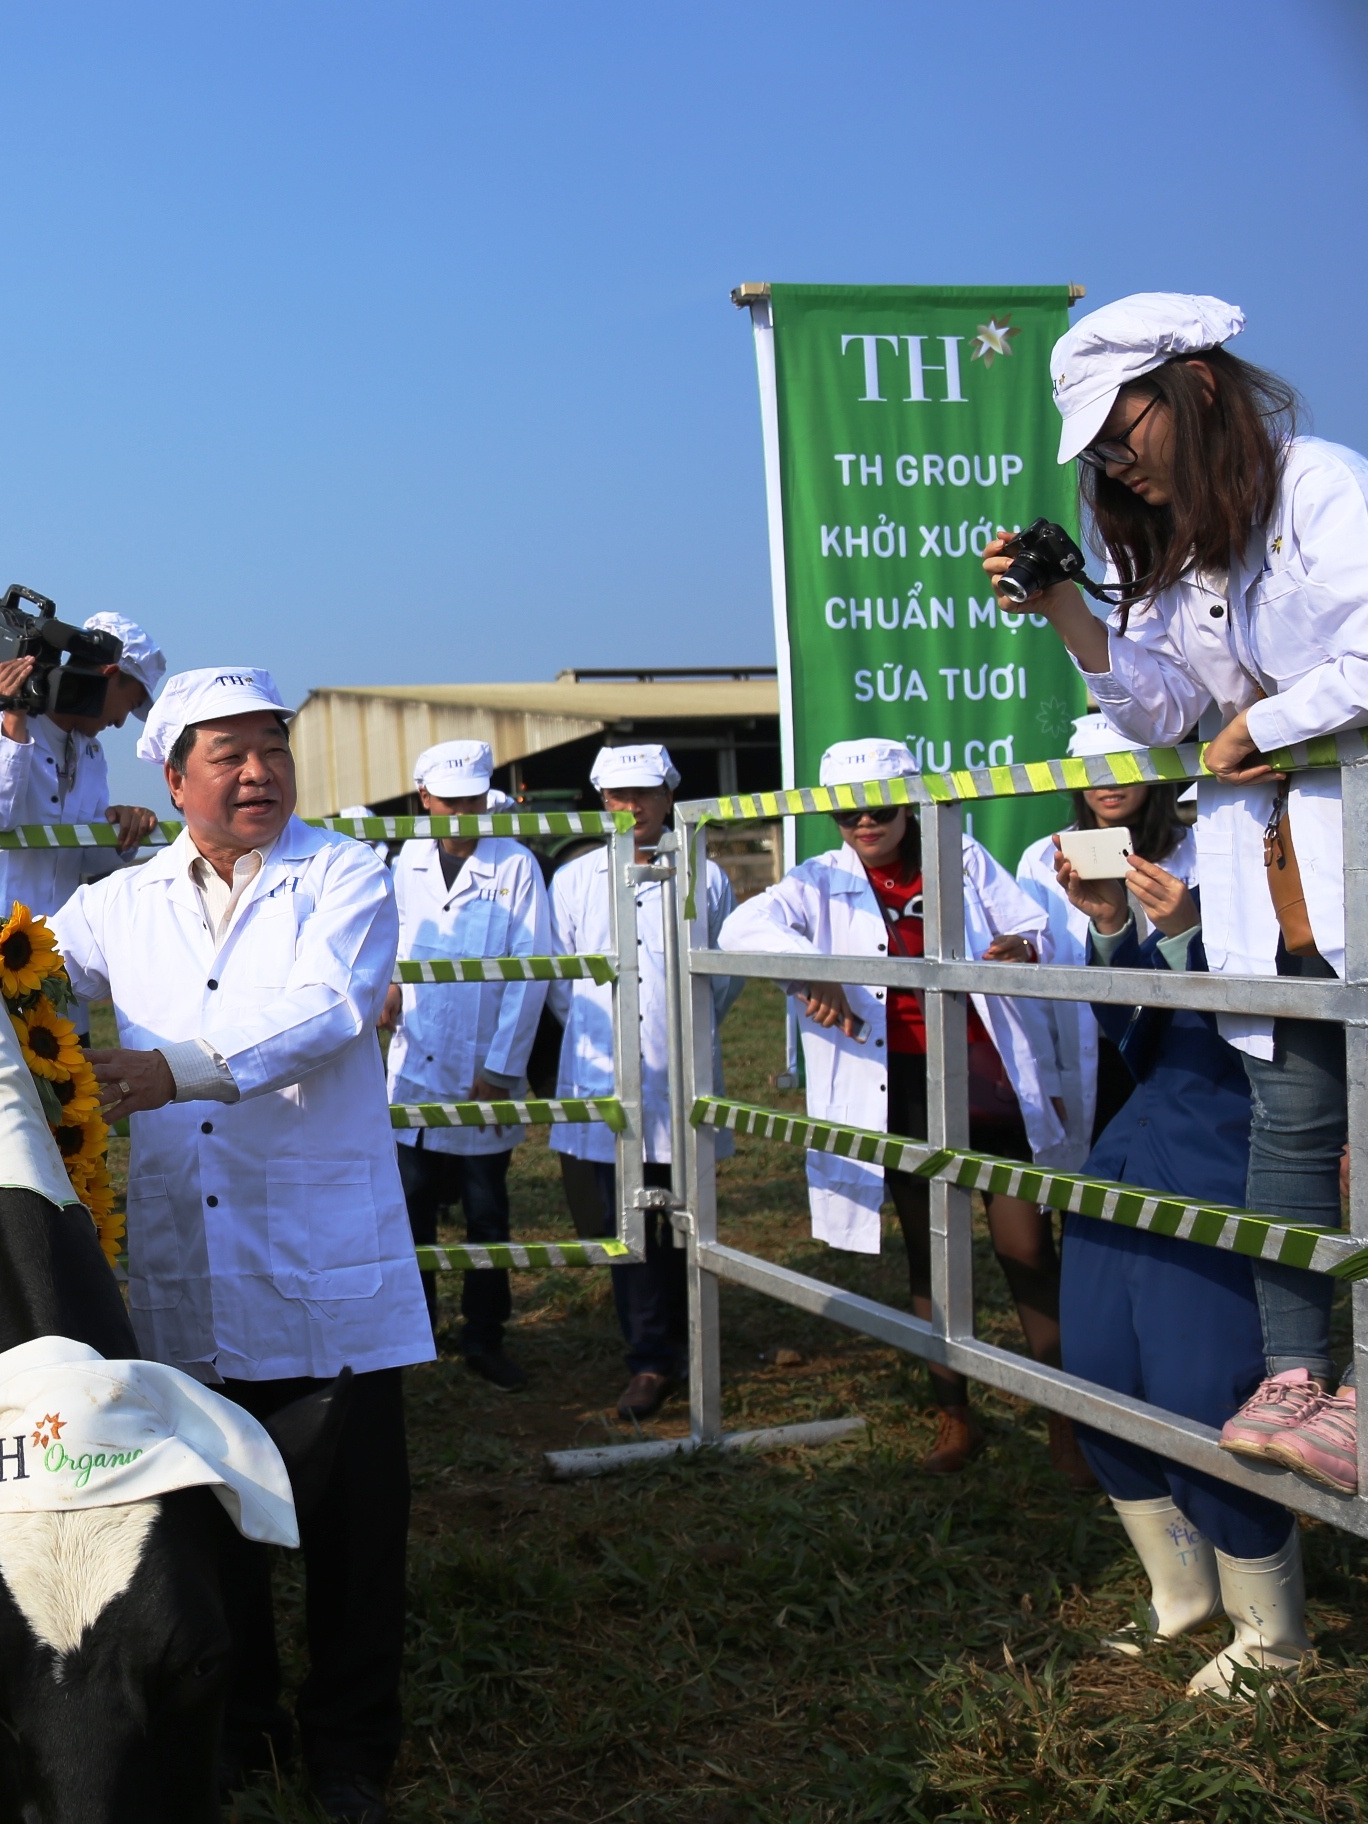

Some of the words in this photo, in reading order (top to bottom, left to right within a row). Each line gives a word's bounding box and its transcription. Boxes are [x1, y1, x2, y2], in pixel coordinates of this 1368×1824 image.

[841, 334, 969, 402] TH
[834, 454, 883, 486] TH
[896, 454, 1023, 486] GROUP
[820, 513, 907, 558] KHỞI
[918, 516, 1021, 558] XƯỚ
[825, 582, 954, 630] CHUẨN
[215, 675, 245, 686] TH
[854, 662, 928, 702] SỮA
[939, 662, 1026, 701] TƯƠI
[446, 758, 463, 768] TH
[620, 755, 636, 764] TH
[845, 754, 865, 764] TH
[905, 735, 951, 773] ỮU
[964, 735, 1014, 770] CƠ
